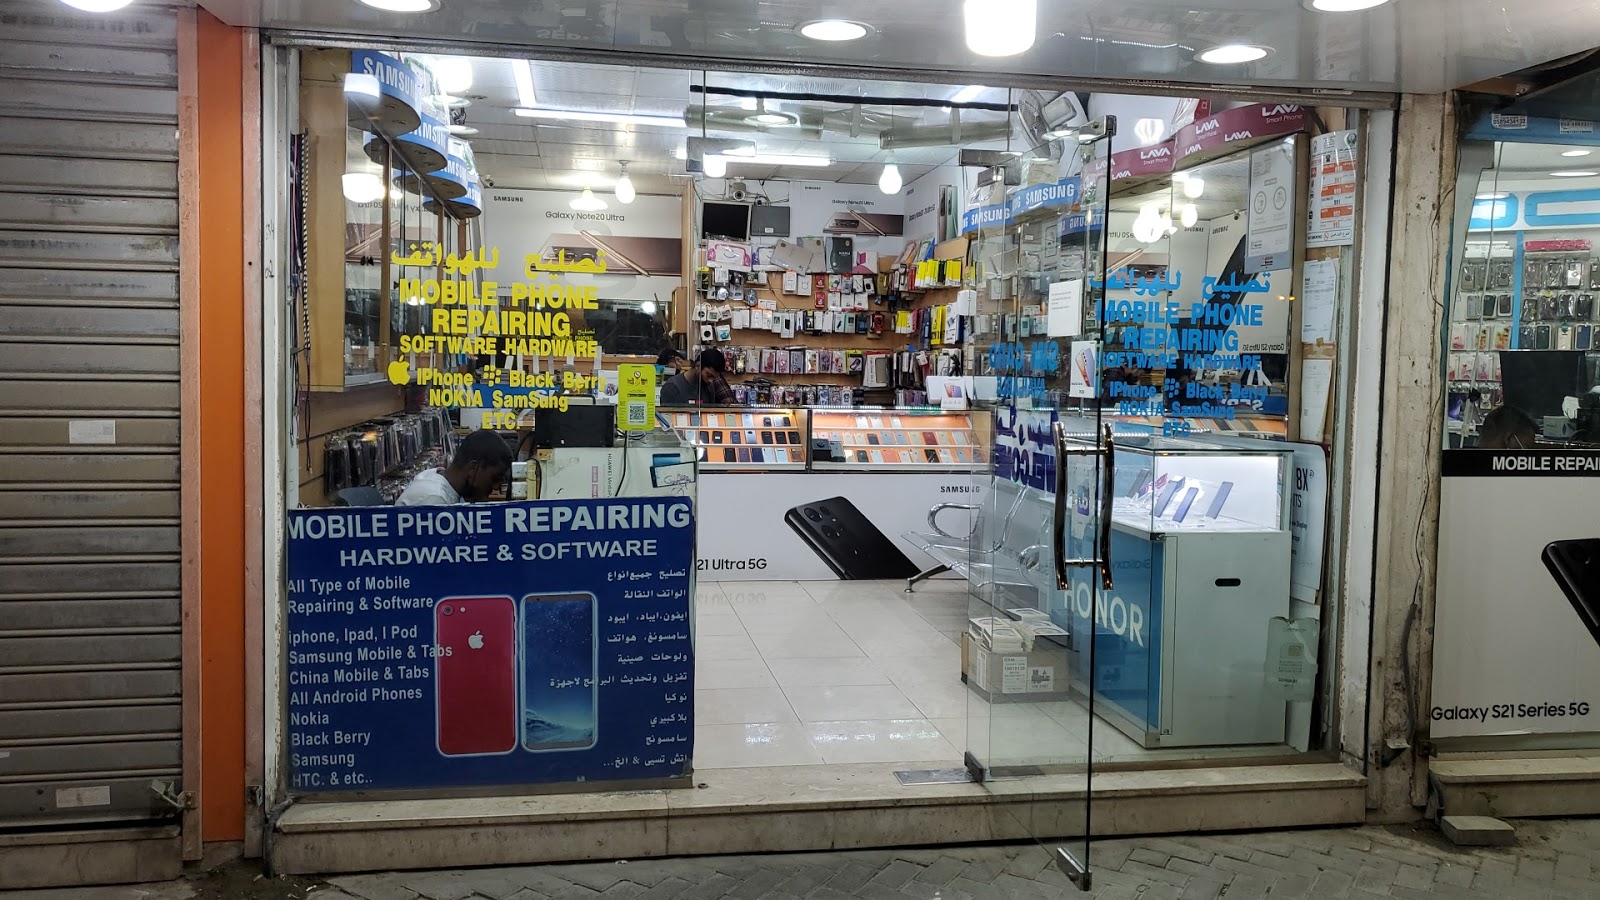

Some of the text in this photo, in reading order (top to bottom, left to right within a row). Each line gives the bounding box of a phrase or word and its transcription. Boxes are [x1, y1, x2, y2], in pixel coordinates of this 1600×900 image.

[1262, 104, 1304, 117] LAVA
[1266, 116, 1283, 124] Smart
[1196, 119, 1219, 134] LAVA
[1225, 131, 1252, 142] LAVA
[1140, 147, 1171, 160] LAVA
[1185, 143, 1202, 155] LAVA
[1112, 170, 1131, 180] LAVA
[1025, 183, 1075, 206] SAMSUNG
[545, 211, 625, 222] Galaxy Note20 Ultra
[971, 207, 1011, 226] SAMSUNG
[391, 242, 607, 280] تصليح للهواتف
[400, 279, 599, 309] MOBILE PHONE
[1202, 271, 1271, 300] تصليح
[432, 309, 570, 337] REPAIRING
[1191, 303, 1263, 326] PHONE
[400, 335, 598, 358] SOFTWARE HARDWARE
[1124, 327, 1239, 351] REPAIRING
[1184, 354, 1261, 370] HARDWARE
[417, 368, 474, 386] IPhone
[509, 370, 555, 388] Black
[563, 371, 607, 392] Berry
[429, 389, 483, 407] NOKIA
[492, 389, 568, 412] SamSung
[1110, 381, 1268, 401] IPhone Black Berry
[1119, 400, 1164, 416] NOKIA
[1171, 402, 1236, 421] SamSung
[1492, 456, 1600, 471] MOBILE REPAI
[1296, 467, 1308, 491] 8X
[940, 485, 980, 493] SAMSUNG
[288, 503, 690, 540] MOBILE PHONE REPAIRING
[340, 539, 658, 567] HARDWARE & SOFTWARE
[659, 568, 686, 579] تصليح
[712, 558, 746, 570] Ultra
[748, 558, 768, 570] 5G
[288, 575, 411, 596] All Type of Mobile
[288, 596, 434, 616] Repairing & Software
[1064, 579, 1145, 647] HONOR
[288, 624, 418, 647] iphone, Ipad, I Pod
[606, 632, 637, 643] هواتف
[289, 644, 453, 666] Samsung Mobile & Tabs
[617, 652, 688, 665] ولوحات صينية
[290, 665, 430, 685] China Mobile & Tabs
[290, 687, 423, 705] All Android Phones
[290, 711, 329, 726] Nokia
[1431, 702, 1590, 722] Galaxy S21 Series 5G
[291, 730, 371, 746] Black Berry
[291, 753, 355, 767] Samsung
[632, 756, 640, 765] &
[330, 772, 339, 785] &
